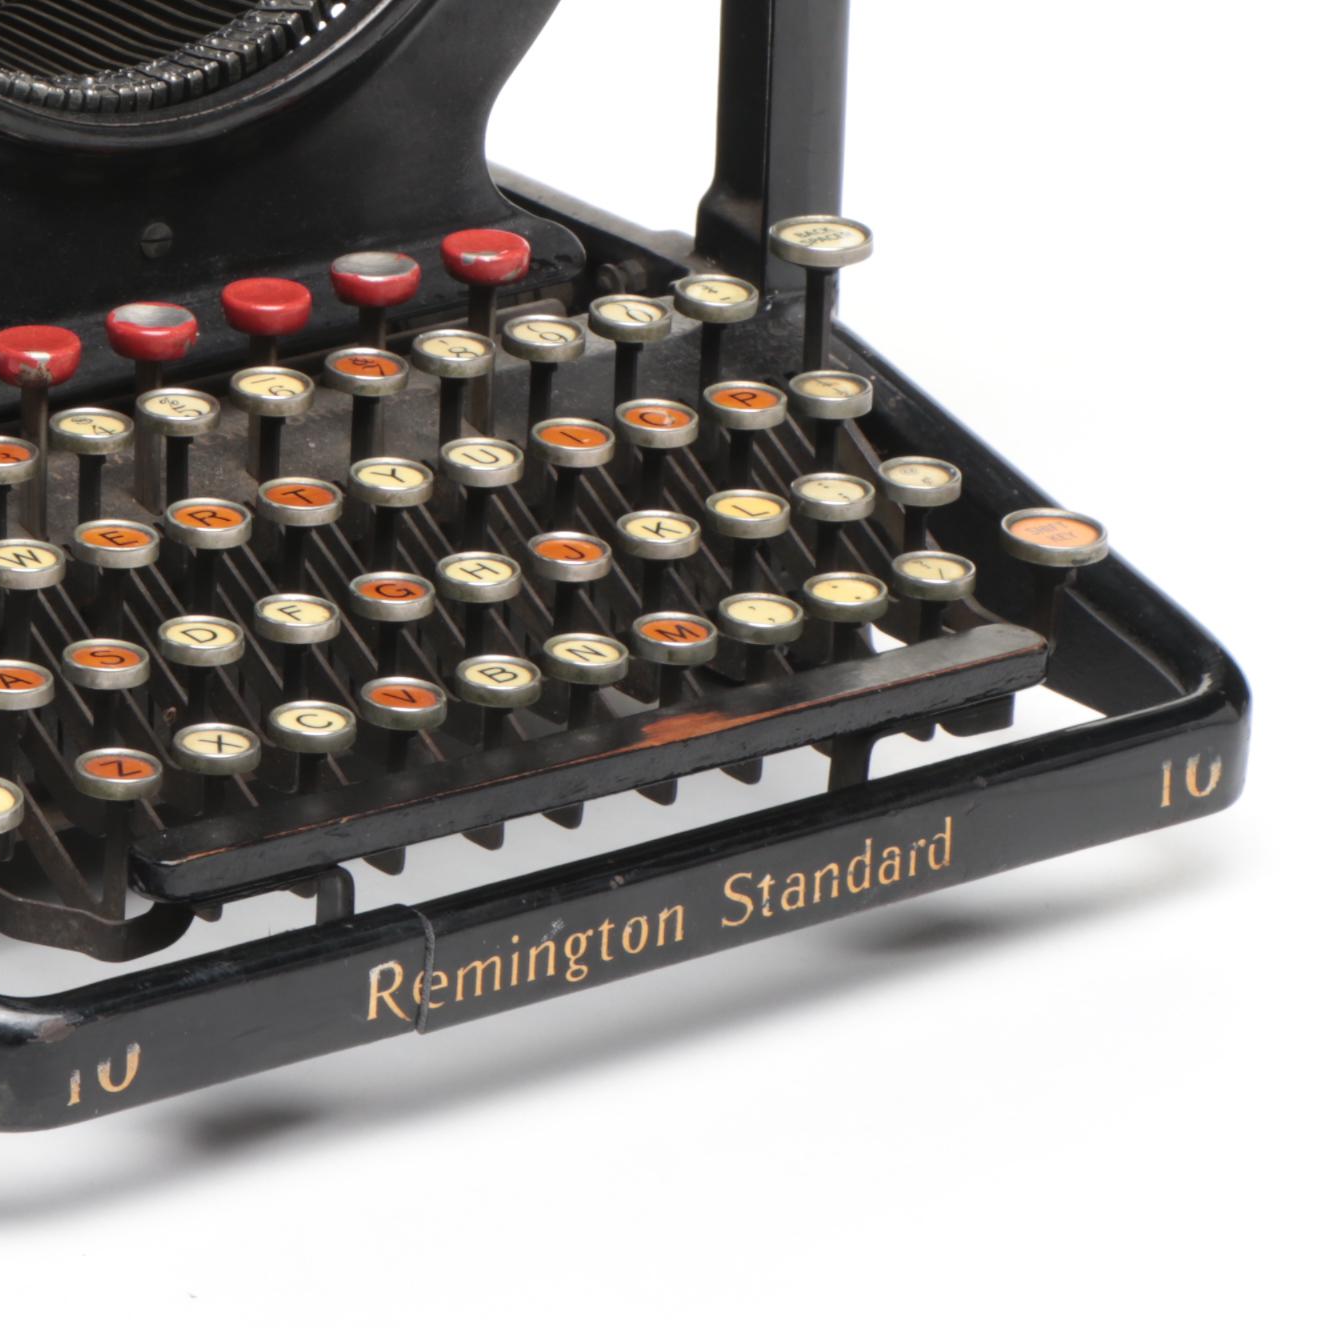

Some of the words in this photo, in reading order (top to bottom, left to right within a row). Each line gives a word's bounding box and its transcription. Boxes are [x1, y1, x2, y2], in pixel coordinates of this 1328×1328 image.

[731, 392, 757, 407] P
[462, 450, 499, 464] U
[370, 469, 408, 482] Y
[280, 490, 318, 504] T
[731, 503, 769, 517] L
[189, 510, 230, 526] R
[643, 522, 682, 538] K
[98, 532, 137, 546] E
[461, 564, 497, 579] H
[375, 583, 415, 598] G
[278, 606, 306, 621] F
[181, 629, 217, 642] D
[656, 626, 700, 641] M
[90, 651, 125, 664] S
[567, 644, 606, 660] N
[0, 674, 31, 688] A
[480, 667, 517, 683] B
[384, 690, 416, 703] V
[297, 714, 332, 730] C
[198, 735, 238, 752] X
[100, 760, 141, 776] Z
[365, 902, 686, 1021] Remington
[720, 815, 954, 928] Standard
